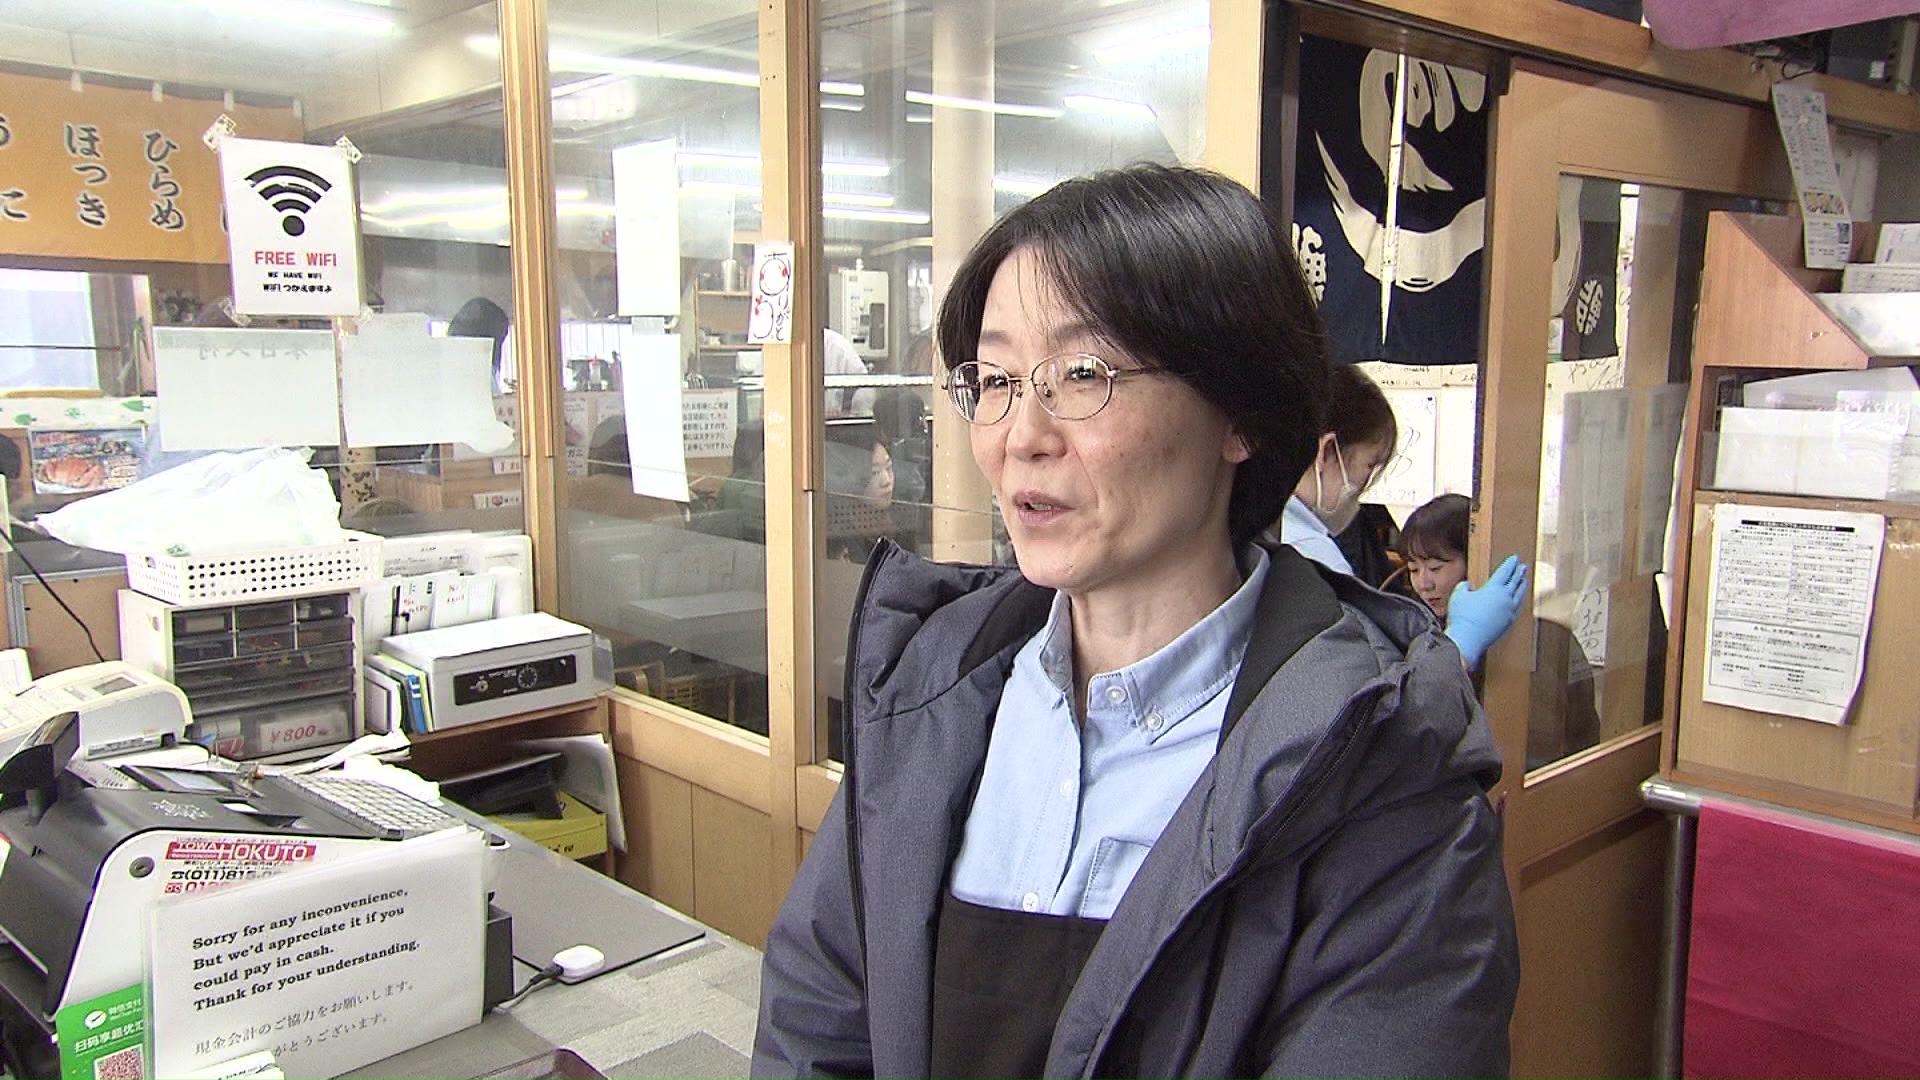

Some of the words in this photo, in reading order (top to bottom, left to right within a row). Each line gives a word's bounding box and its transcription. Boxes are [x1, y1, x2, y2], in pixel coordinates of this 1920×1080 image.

[146, 132, 184, 230] ひらめ
[255, 251, 296, 265] FREE
[177, 842, 218, 850] TOWA
[218, 843, 308, 860] HOKUTO
[192, 931, 239, 951] Sorry
[243, 923, 265, 938] for
[269, 915, 298, 931] any
[193, 955, 223, 971] But
[268, 921, 347, 951] appreciate
[350, 916, 362, 929] it
[366, 911, 377, 924] if
[380, 906, 405, 923] you
[193, 969, 239, 991] could
[244, 961, 272, 980] pay
[276, 955, 292, 968] in
[296, 944, 335, 962] cash.
[193, 988, 247, 1012] Thank
[251, 979, 273, 995] for
[277, 969, 313, 991] your
[317, 938, 420, 976] understanding.
